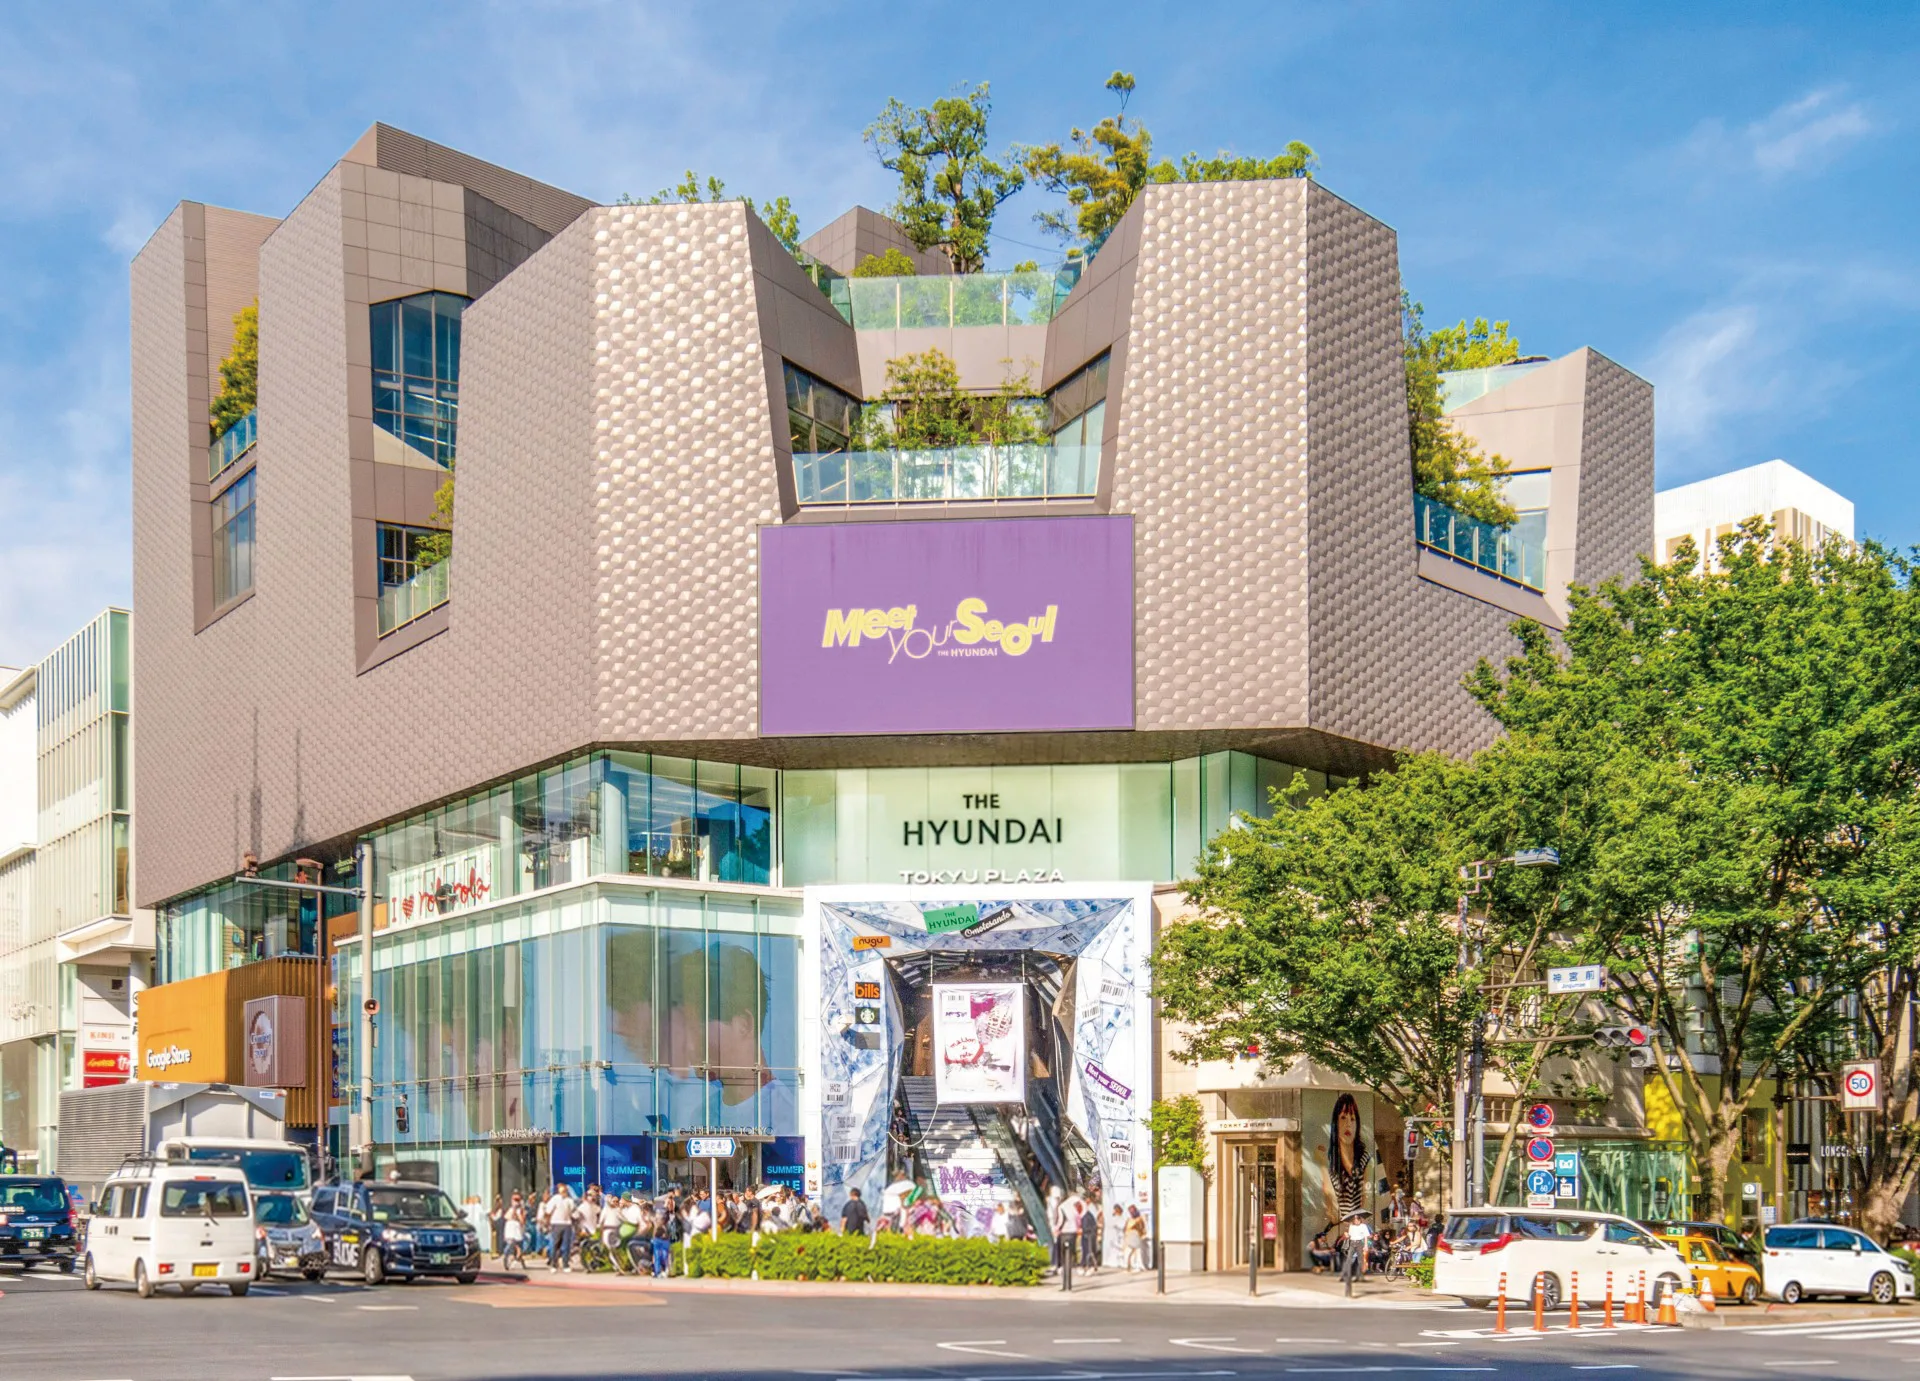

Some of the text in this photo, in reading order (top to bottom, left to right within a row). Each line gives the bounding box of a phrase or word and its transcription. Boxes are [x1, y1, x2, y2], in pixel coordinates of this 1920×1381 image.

[822, 604, 917, 648] Meet
[953, 597, 1058, 656] Seoul
[888, 619, 957, 664] your
[951, 648, 998, 657] HYUNDAI
[963, 794, 1001, 809] THE
[903, 818, 1062, 846] HYUNDAI
[901, 868, 1064, 884] TOKYU PLAZA
[929, 915, 976, 930] HYUNDAI
[964, 911, 1012, 937] Omotesando
[858, 938, 883, 948] nugu
[1553, 970, 1595, 983] 神宮前
[855, 983, 880, 998] bills
[147, 1046, 172, 1071] Google
[170, 1045, 192, 1064] Store
[1109, 1080, 1128, 1098] SEOUL
[1851, 1078, 1868, 1090] 50
[564, 1166, 586, 1175] SUMMER
[606, 1166, 648, 1175] SUMMER
[767, 1165, 804, 1174] SUMMER
